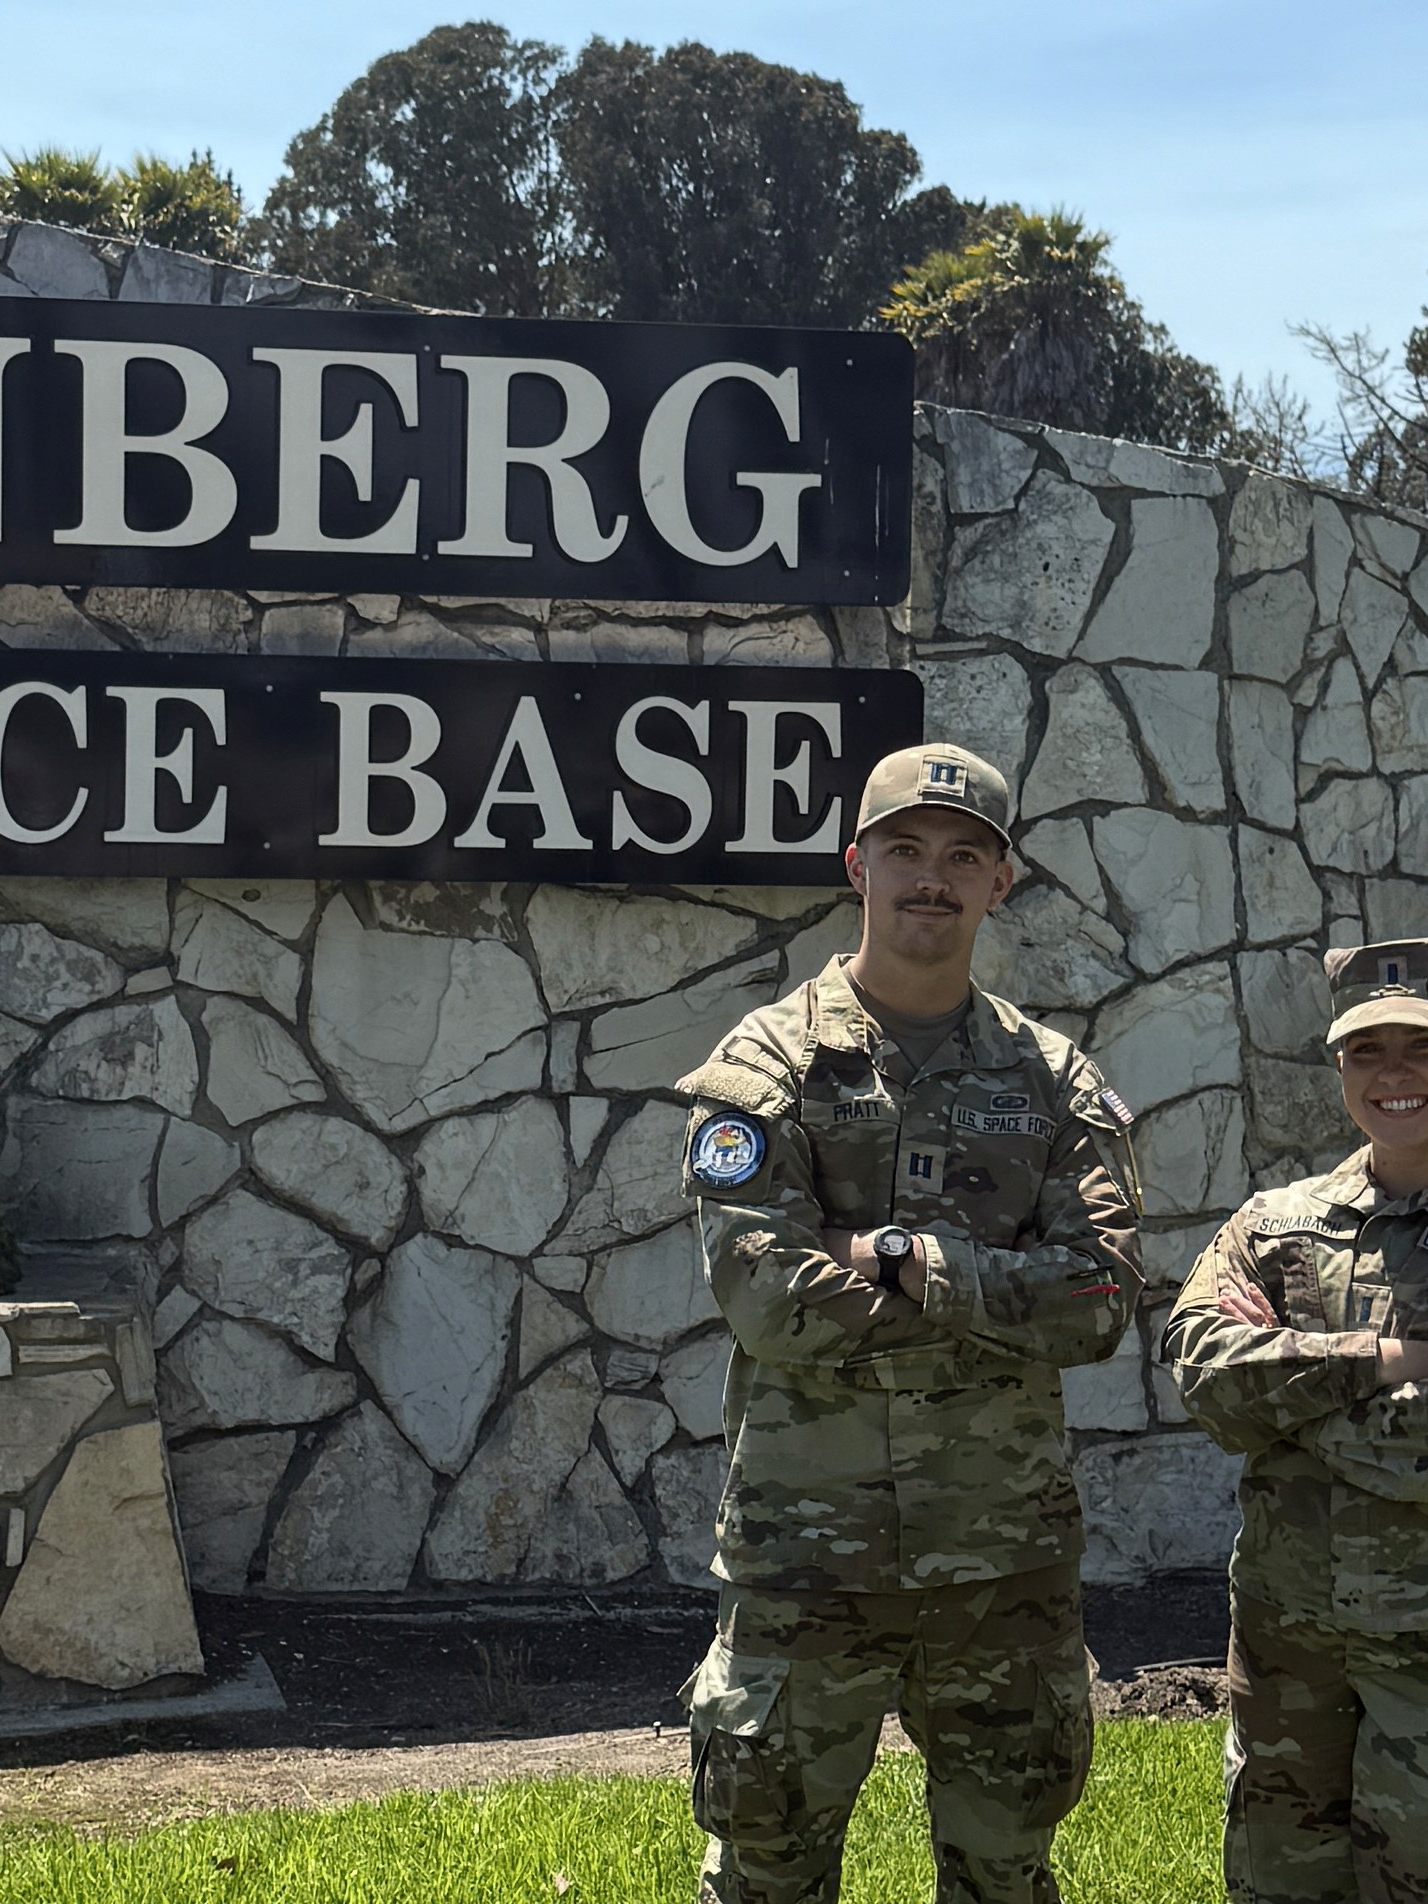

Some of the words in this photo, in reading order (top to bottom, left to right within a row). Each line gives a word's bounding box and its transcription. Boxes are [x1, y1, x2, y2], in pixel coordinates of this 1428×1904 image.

[318, 691, 842, 855] BASE
[833, 1100, 880, 1122] PRATT
[983, 1116, 1022, 1133] SPACE
